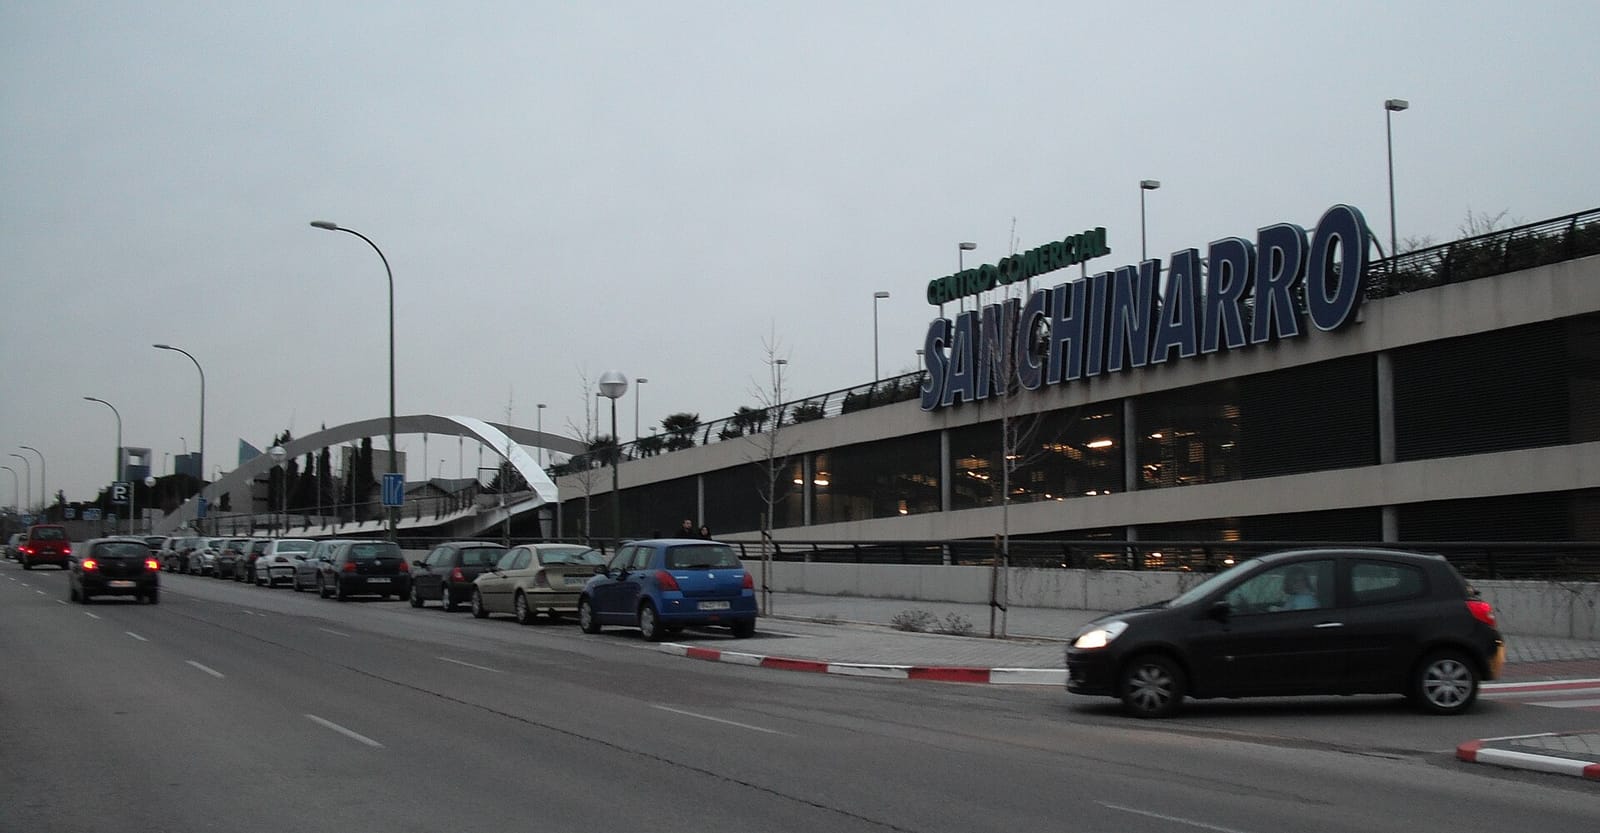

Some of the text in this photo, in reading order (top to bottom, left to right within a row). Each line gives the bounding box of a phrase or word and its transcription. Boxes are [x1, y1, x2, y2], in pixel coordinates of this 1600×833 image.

[920, 204, 1369, 411] SANCHINARRO
[927, 227, 1111, 305] CENTRO COMERCIAL
